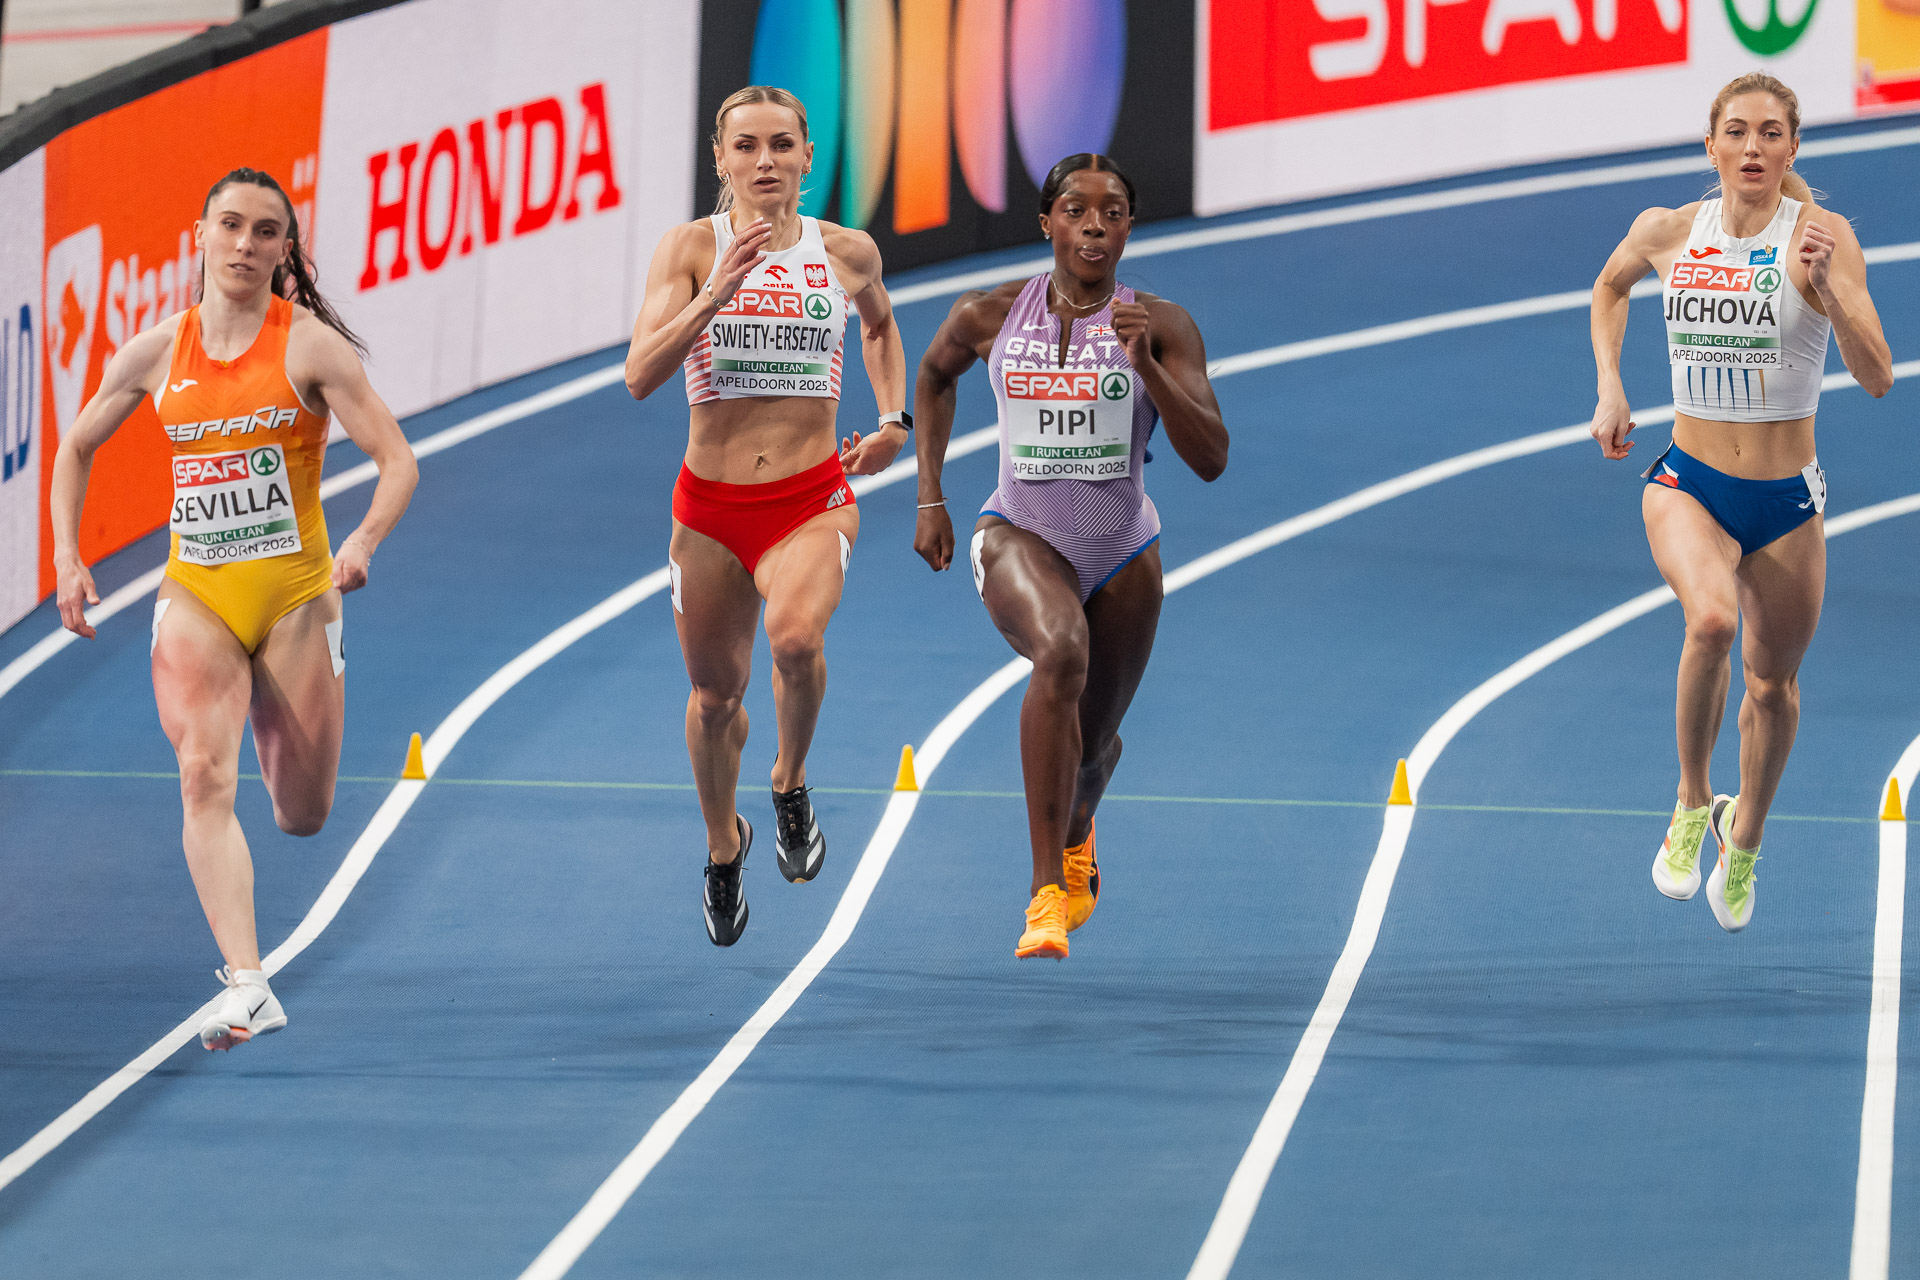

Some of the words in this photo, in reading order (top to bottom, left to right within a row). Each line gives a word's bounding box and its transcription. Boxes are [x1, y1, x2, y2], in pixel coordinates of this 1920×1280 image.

[357, 80, 621, 292] HONDA
[1672, 266, 1752, 288] SPAR
[720, 292, 801, 314] SPAR
[1666, 290, 1776, 326] JÍCHOVÁ
[712, 323, 832, 352] SWIETY-ERSETIC
[1691, 335, 1712, 345] RUN
[1004, 337, 1118, 362] GREAT
[1672, 349, 1742, 363] APELDOORN
[1745, 352, 1777, 364] 2025
[743, 362, 767, 371] RUN
[715, 376, 796, 390] APELDOORN
[799, 379, 828, 391] 2025
[1007, 375, 1096, 397] SPAR
[164, 405, 299, 442] ESPAÑA
[1039, 409, 1095, 435] PIPI
[1036, 447, 1061, 458] RUN
[175, 457, 247, 485] SPAR
[1013, 462, 1095, 475] APELDOORN
[1098, 461, 1126, 475] 2025
[172, 483, 289, 523] SEVILLA
[183, 543, 258, 560] APELDOORN
[262, 536, 295, 551] 2025
[197, 532, 223, 545] RUN
